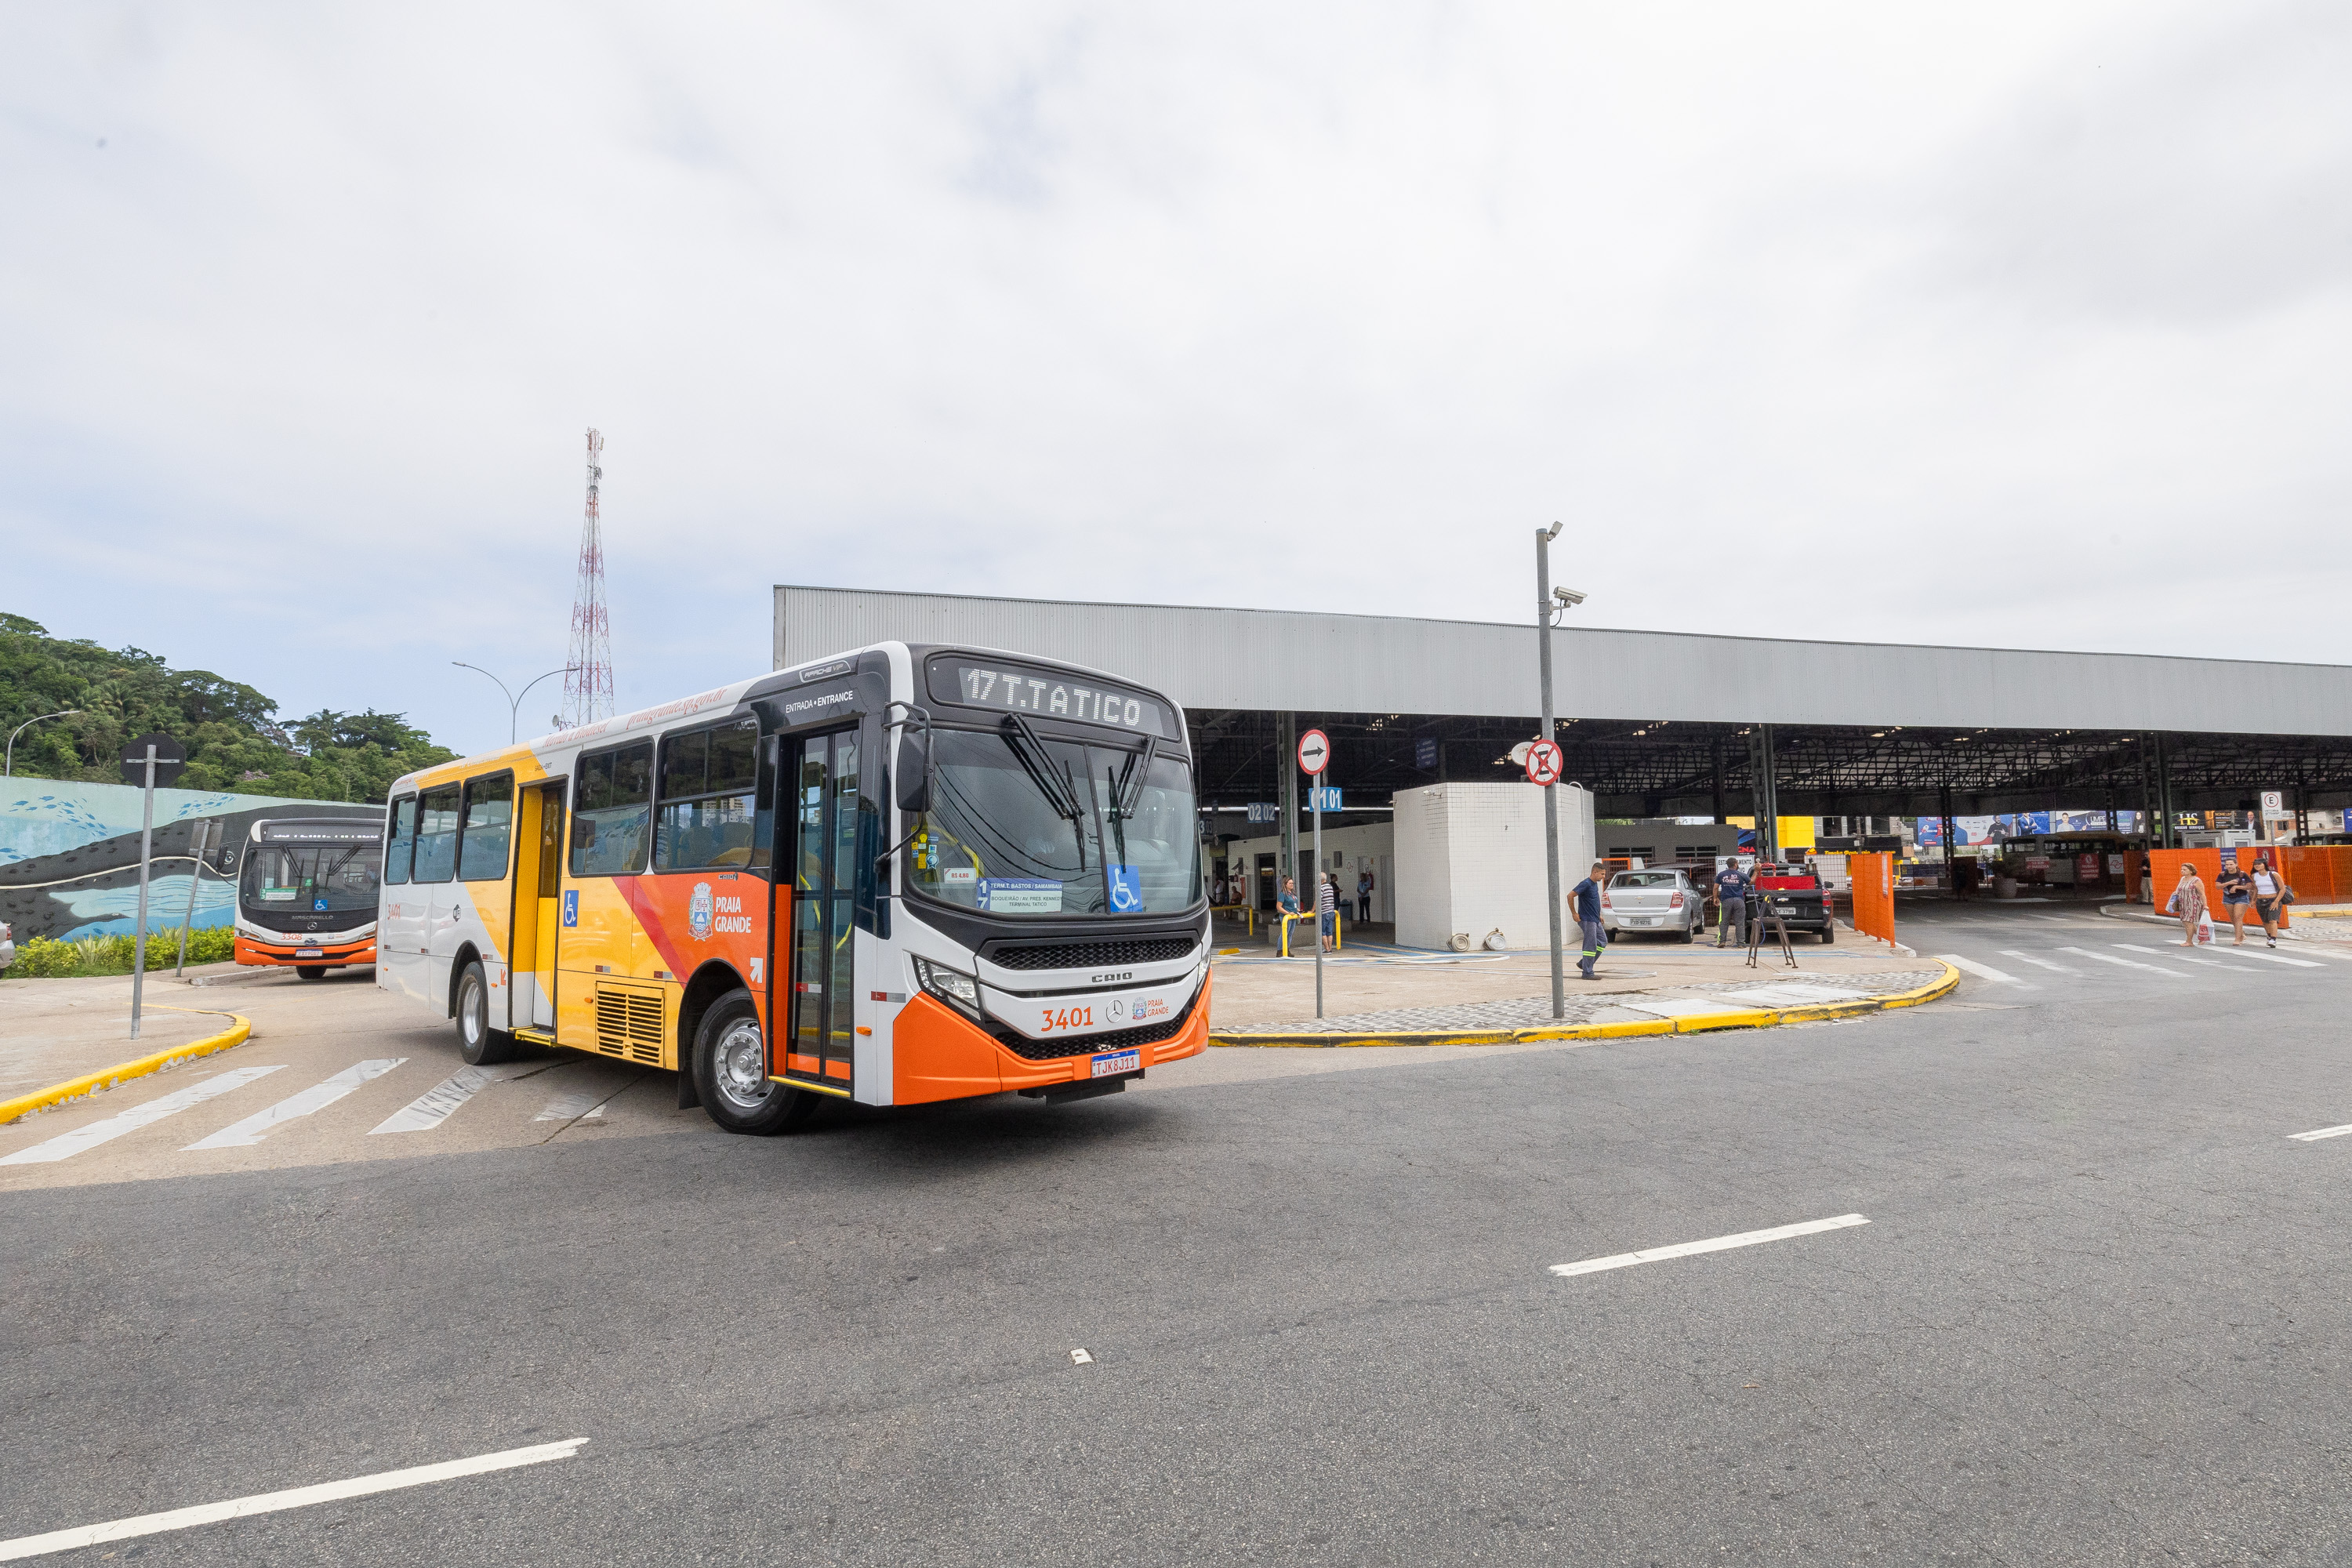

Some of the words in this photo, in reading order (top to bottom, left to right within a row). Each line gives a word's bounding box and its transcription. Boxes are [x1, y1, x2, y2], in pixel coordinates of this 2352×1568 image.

[804, 666, 832, 678] APACHE
[786, 699, 814, 713] ENTRADA
[817, 690, 853, 706] ENTRANCE
[967, 668, 997, 700] 17
[1002, 674, 1141, 726] T.TATICO
[626, 688, 728, 730] praiagrande.sp.gov.br
[1329, 789, 1341, 809] 01
[1248, 804, 1261, 821] 02
[1263, 804, 1276, 821] 02
[2179, 813, 2198, 826] HS
[1207, 820, 1213, 834] 03
[979, 880, 987, 894] 1
[715, 896, 742, 913] PRAIA
[978, 897, 988, 909] 7
[714, 916, 752, 934] GRANDE
[1091, 971, 1133, 983] CAIO
[1147, 998, 1163, 1007] PRAIA
[1040, 1006, 1094, 1032] 3401
[1147, 1006, 1169, 1017] GRANDE
[1096, 1056, 1135, 1075] TJK8J11
